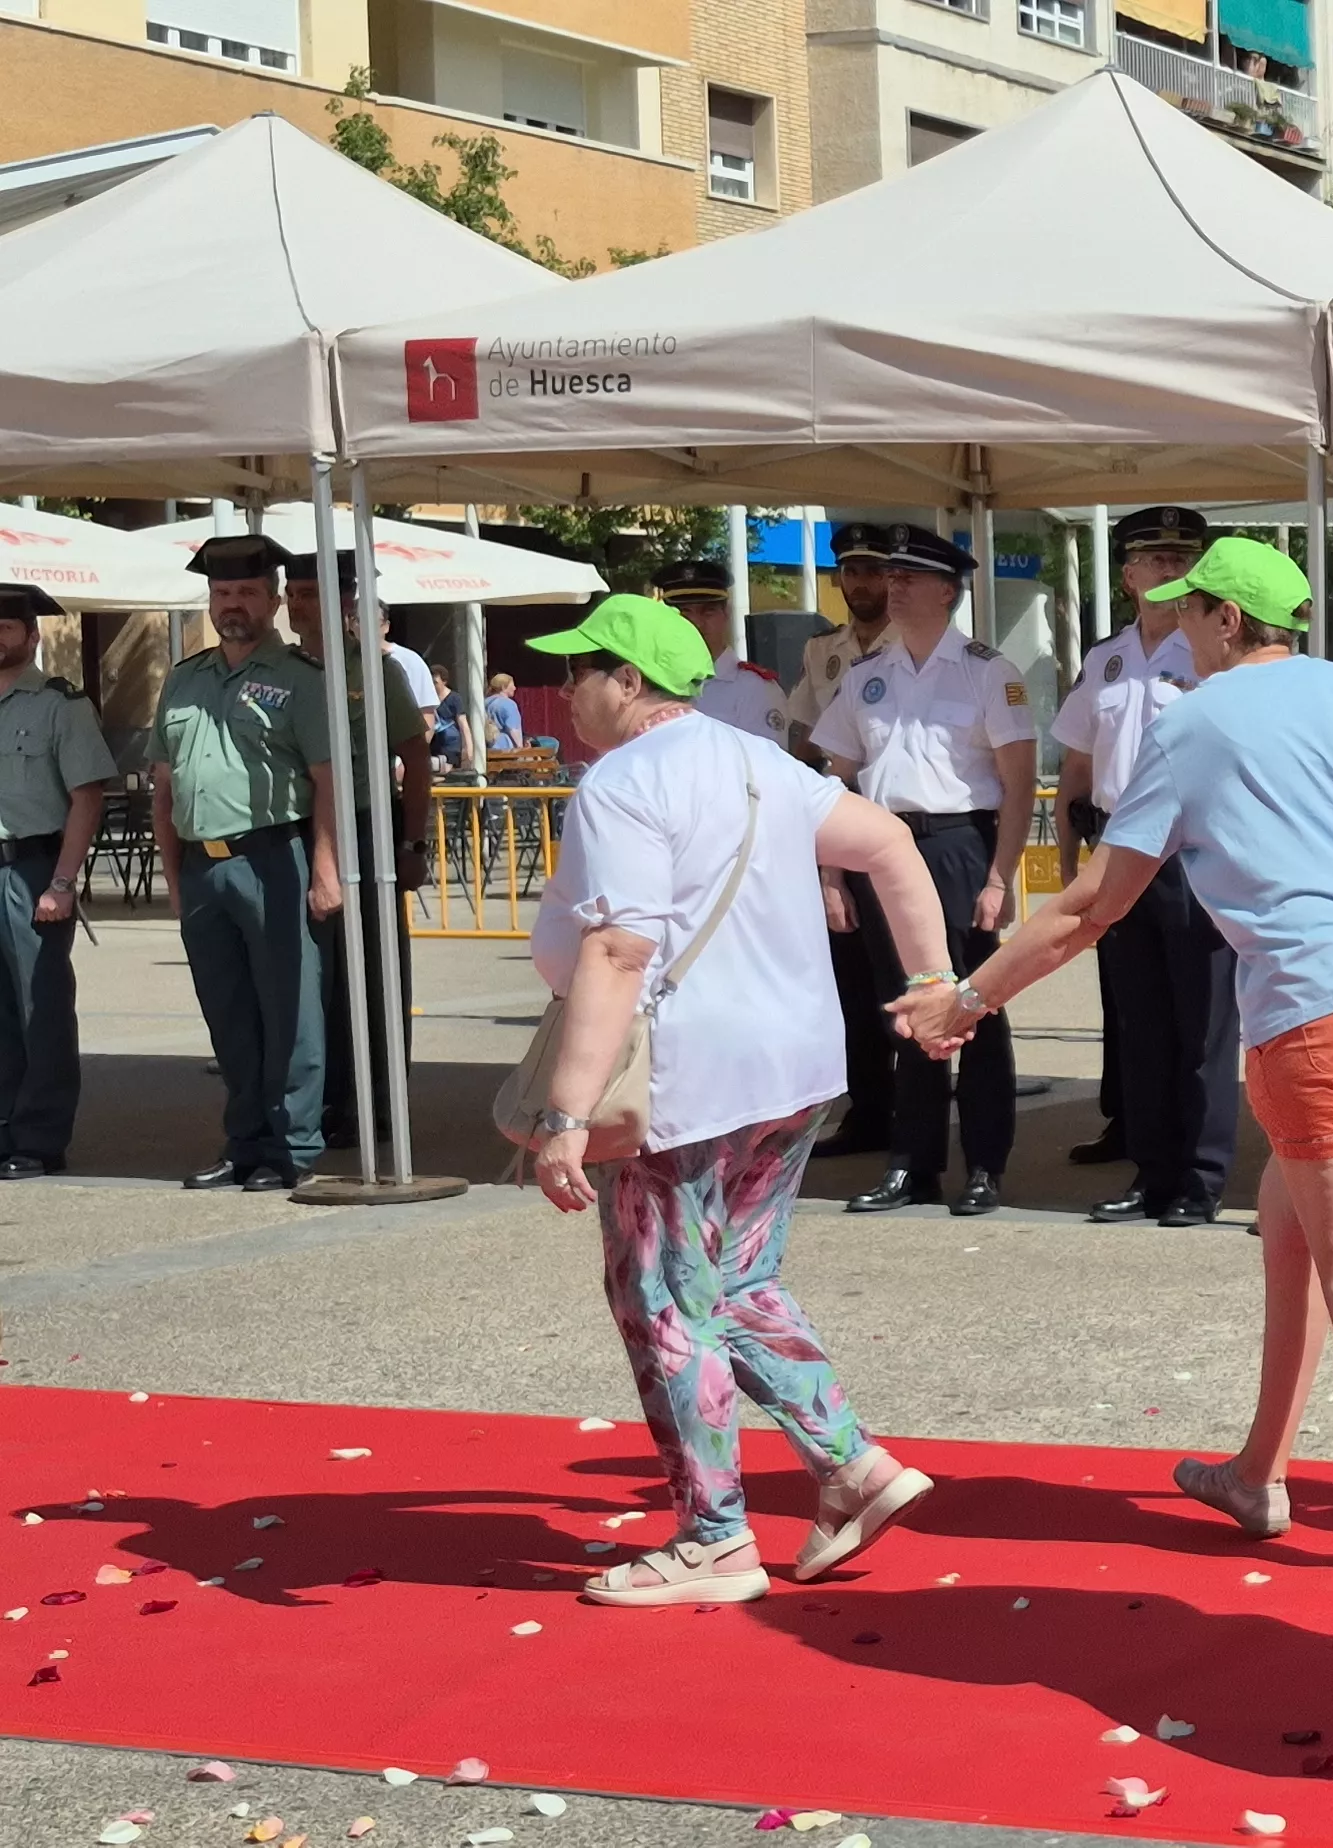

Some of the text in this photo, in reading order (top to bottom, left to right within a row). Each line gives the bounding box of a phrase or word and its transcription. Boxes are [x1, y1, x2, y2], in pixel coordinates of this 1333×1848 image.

[487, 332, 677, 367] Ayuntamiento
[489, 369, 632, 397] de Huesca
[11, 566, 100, 584] VICTORIA
[416, 577, 492, 590] VICTORIA
